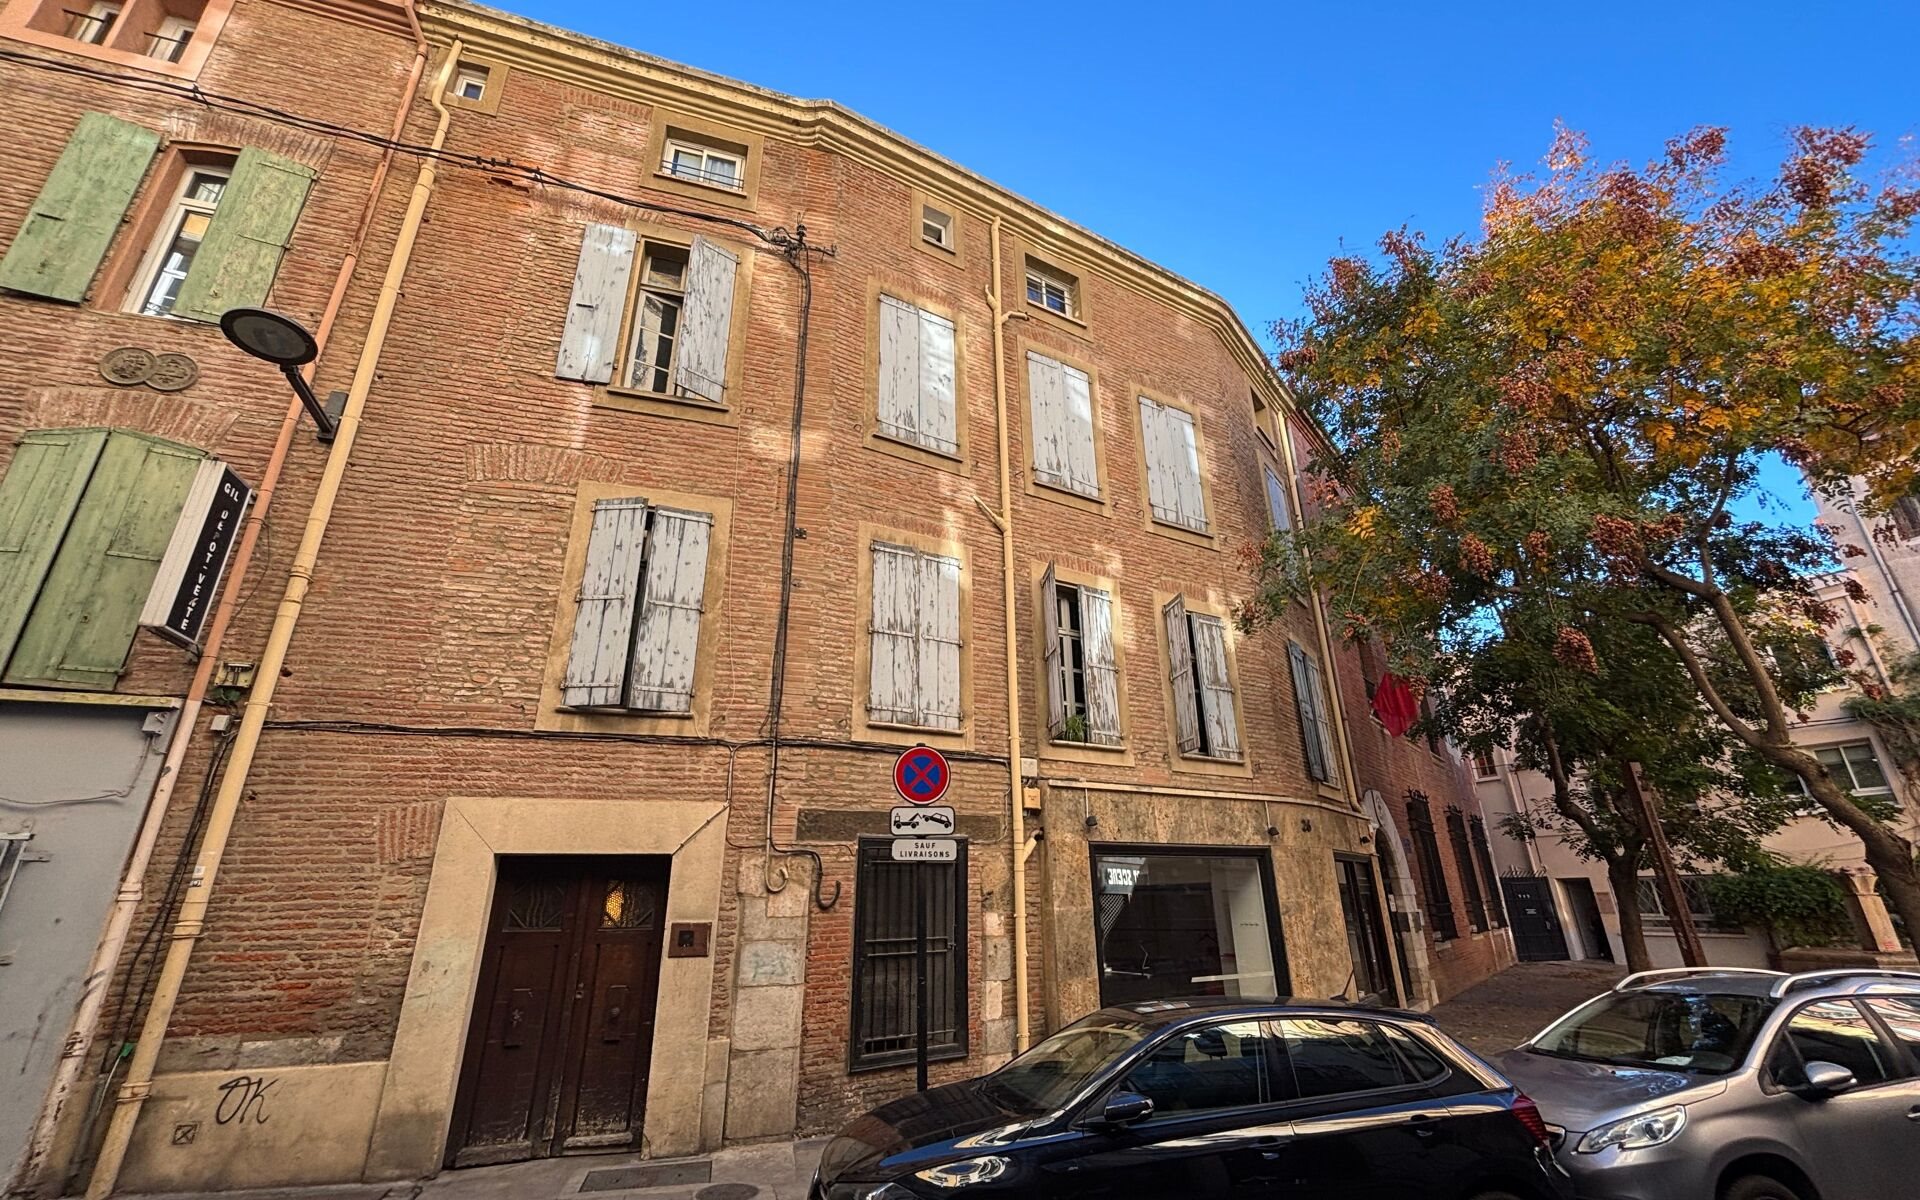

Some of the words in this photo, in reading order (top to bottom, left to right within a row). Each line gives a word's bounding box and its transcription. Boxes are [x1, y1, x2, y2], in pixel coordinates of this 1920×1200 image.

[224, 482, 239, 502] GIL
[899, 850, 950, 858] LIVRAISONS
[216, 1076, 279, 1124] OK
